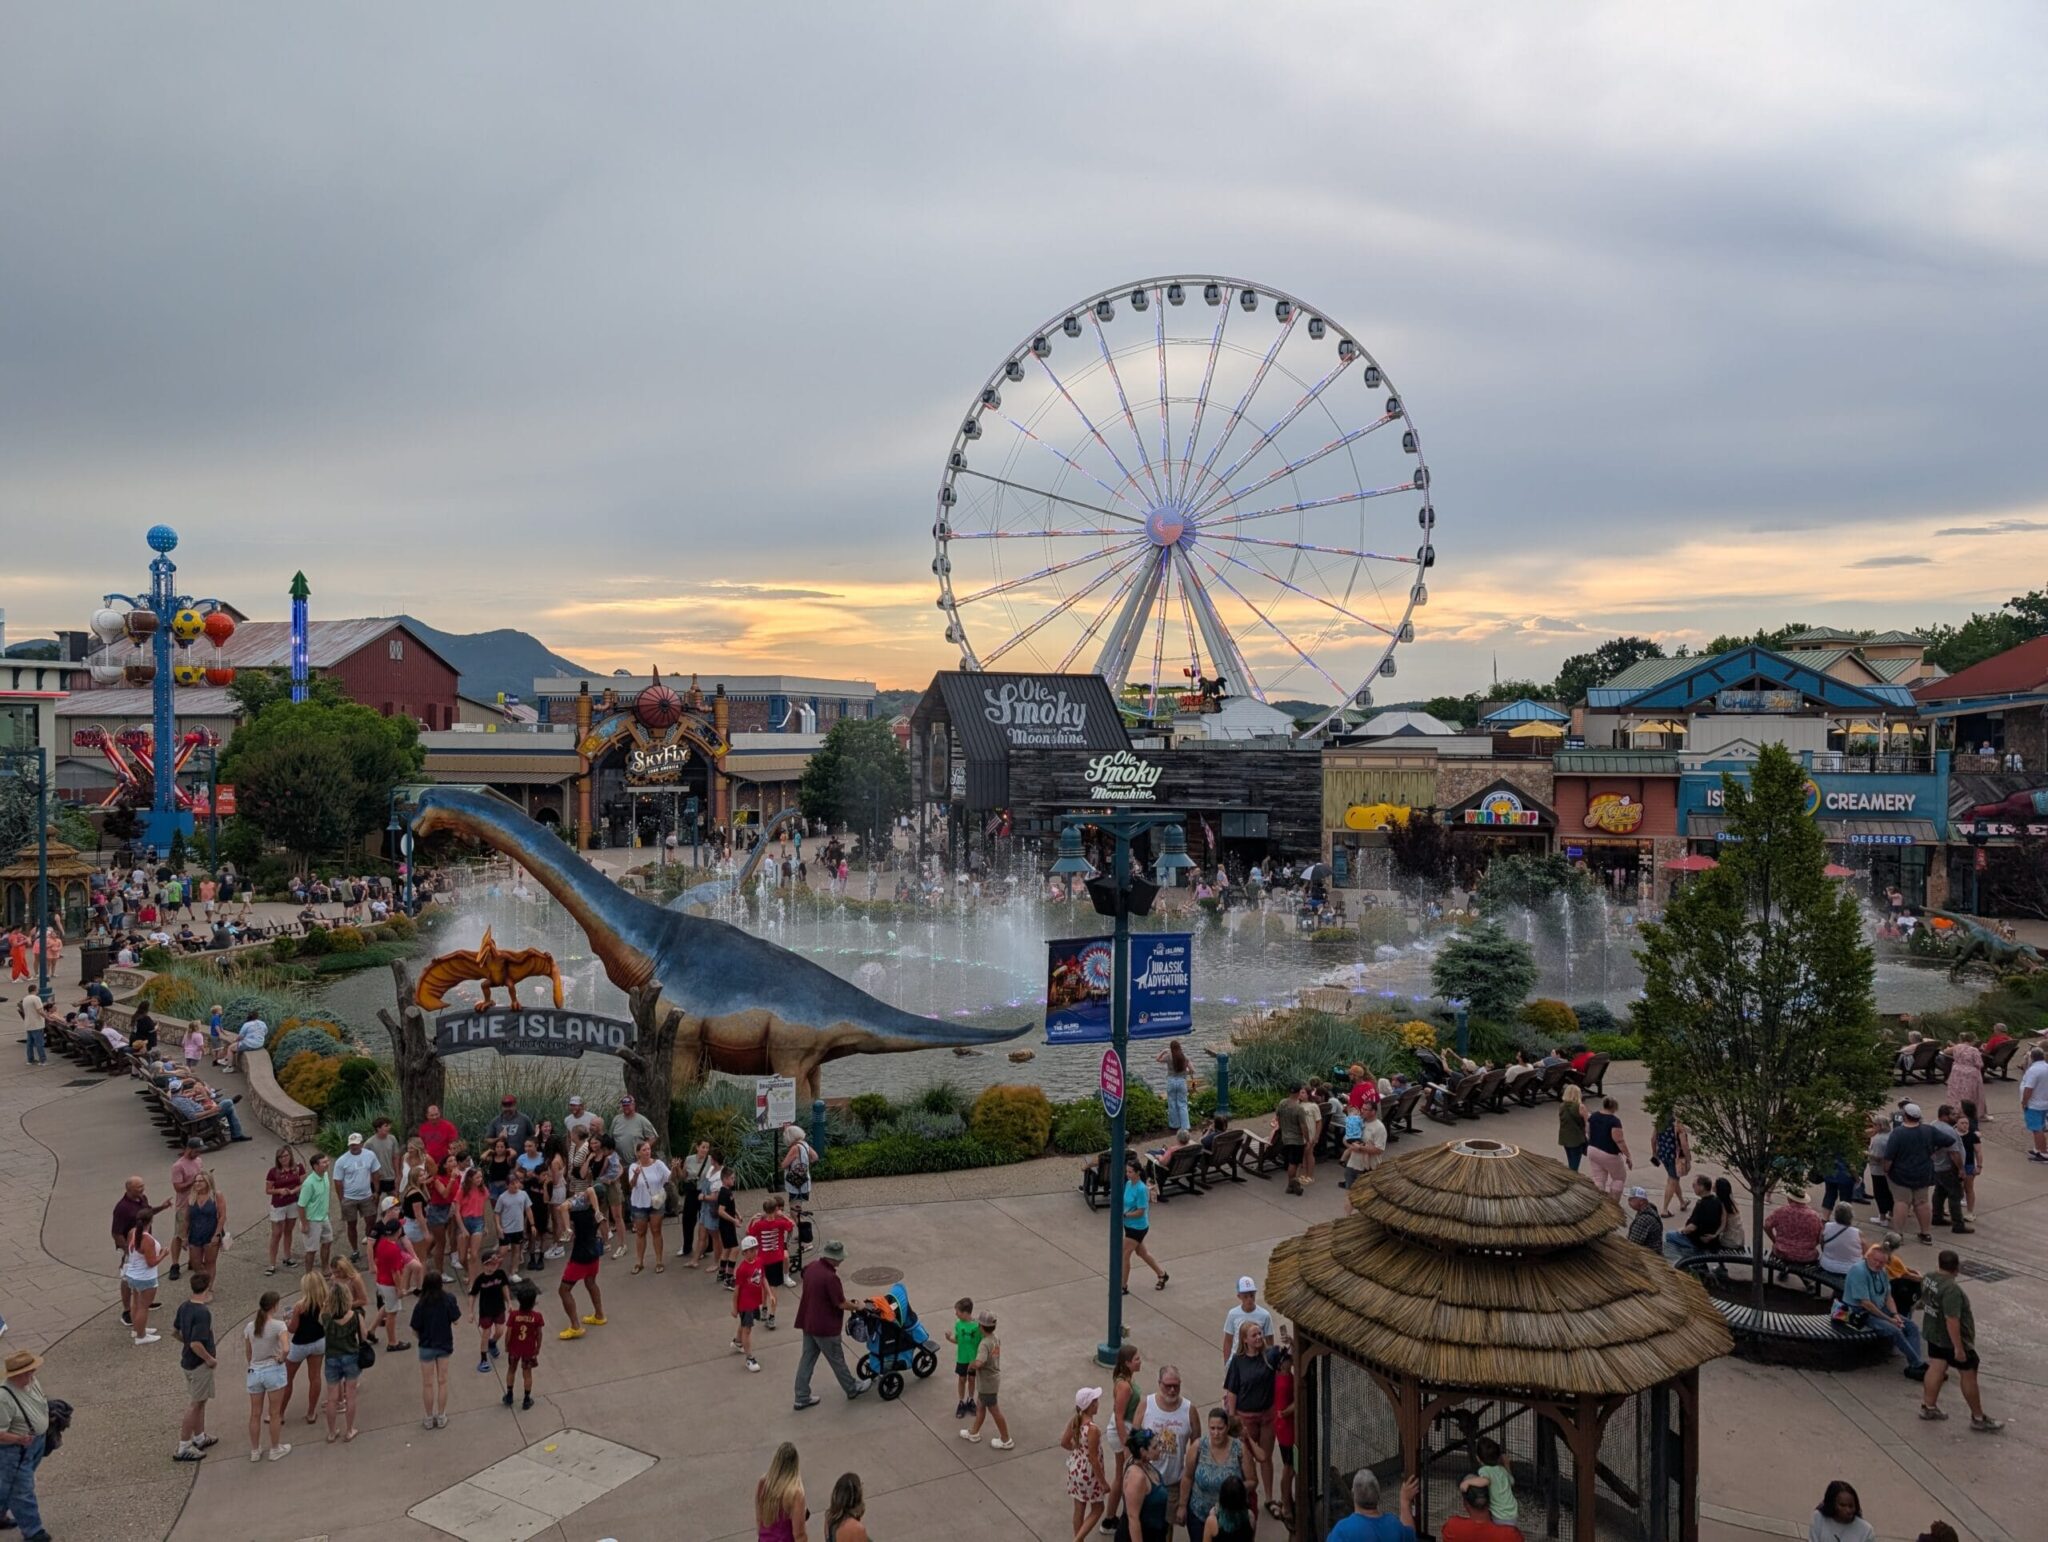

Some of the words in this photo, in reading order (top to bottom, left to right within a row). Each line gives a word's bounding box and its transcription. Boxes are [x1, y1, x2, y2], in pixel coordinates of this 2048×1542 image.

[1019, 678, 1057, 702] Ole
[984, 683, 1087, 731] Smoky
[1007, 728, 1087, 745] Moonshine
[1114, 750, 1141, 766] Ole
[1084, 755, 1163, 788] Smoky
[1091, 785, 1156, 800] Moonshine
[1826, 792, 1916, 811] CREAMERY
[1851, 834, 1912, 844] DESSERTS
[1151, 960, 1184, 974] JURASSIC
[1147, 973, 1188, 988] ADVENTURE
[445, 1015, 505, 1043] THE
[519, 1014, 625, 1048] ISLAND
[518, 1325, 528, 1341] 3
